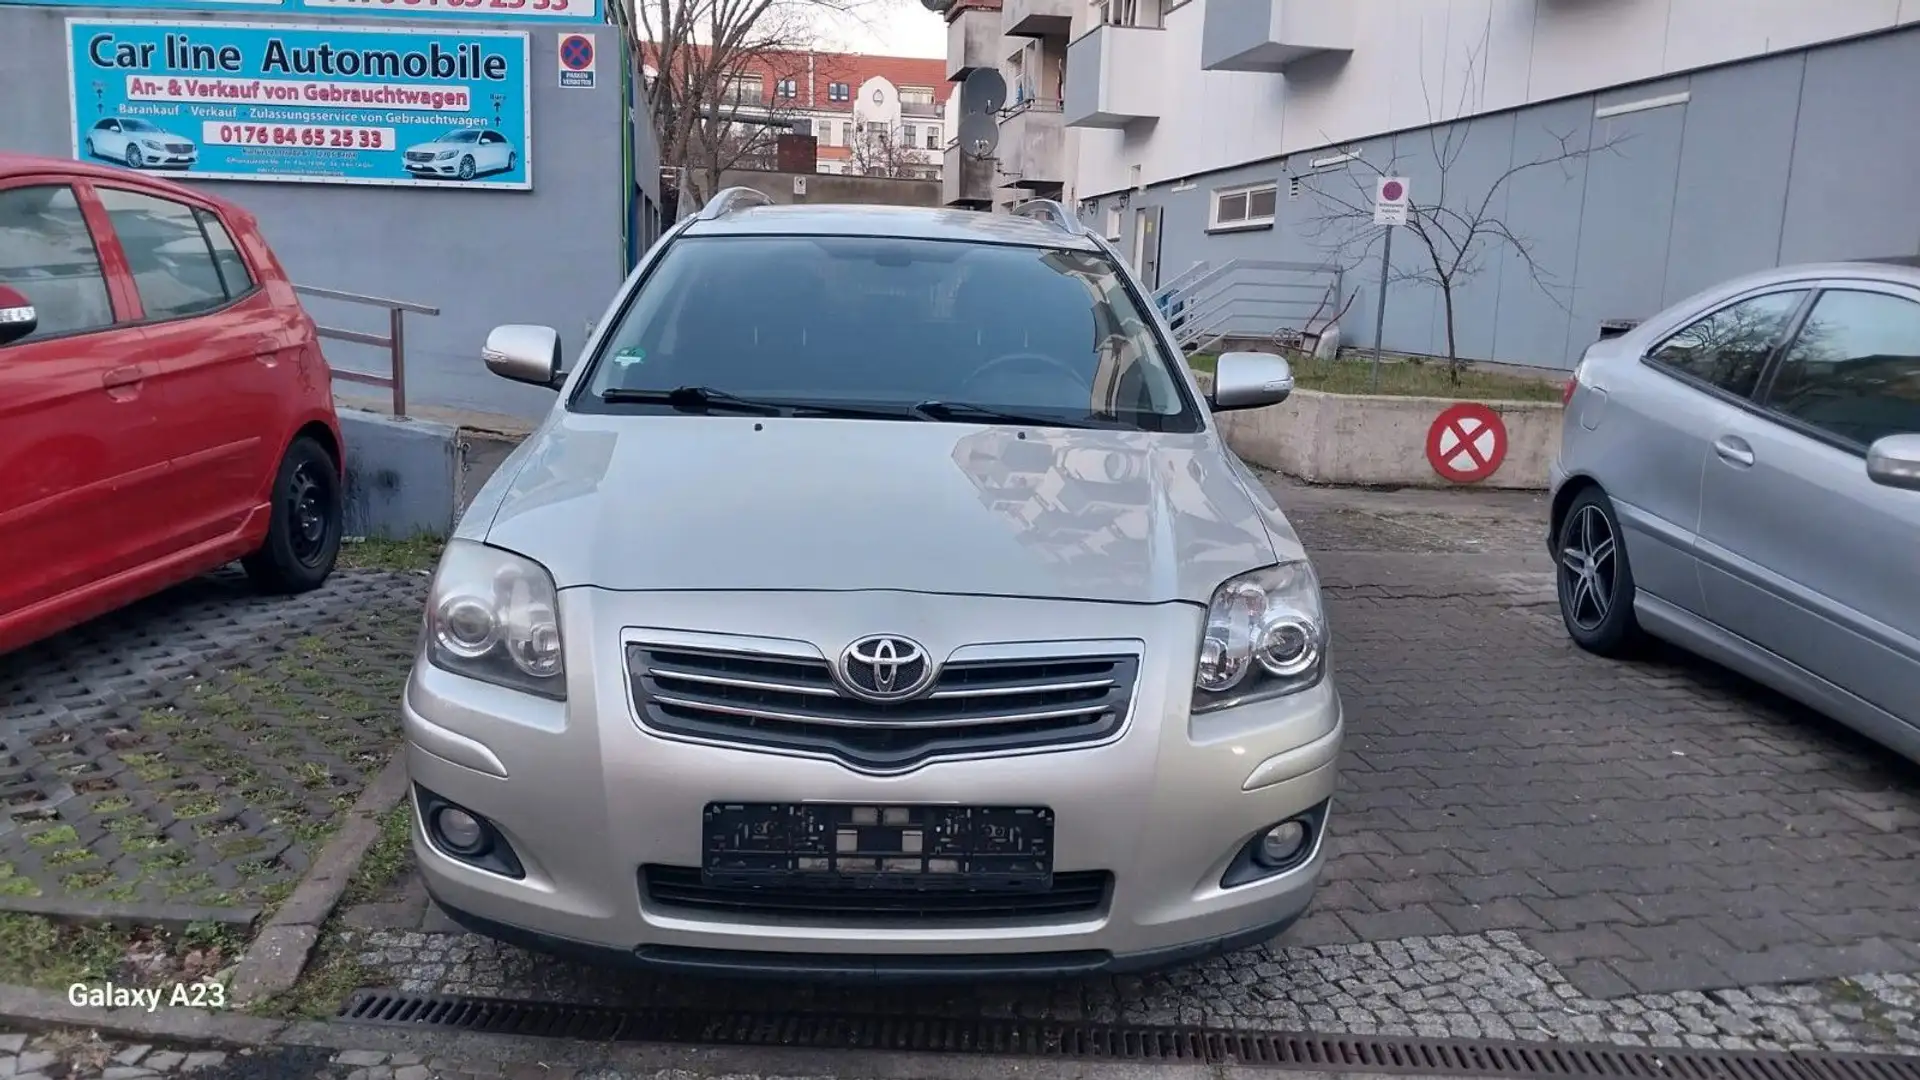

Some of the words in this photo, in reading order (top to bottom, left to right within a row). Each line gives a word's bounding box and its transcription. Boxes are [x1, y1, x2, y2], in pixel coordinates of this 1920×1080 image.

[89, 32, 155, 69] Car
[165, 33, 242, 71] line
[261, 38, 507, 81] Automobile
[130, 77, 163, 96] An-
[167, 79, 182, 97] &
[184, 79, 260, 99] Verkauf
[263, 85, 299, 100] von
[303, 83, 468, 109] Gebrauchtwagen
[118, 103, 179, 117] Barankauf
[191, 106, 237, 118] Verkauf
[249, 108, 357, 123] Zulassungsservice
[361, 113, 382, 123] von
[386, 112, 488, 128] Gebrauchtwagen
[220, 124, 269, 144] 0176
[273, 126, 297, 145] 84
[301, 127, 325, 146] 65
[330, 129, 353, 148] 25
[359, 129, 382, 149] 33
